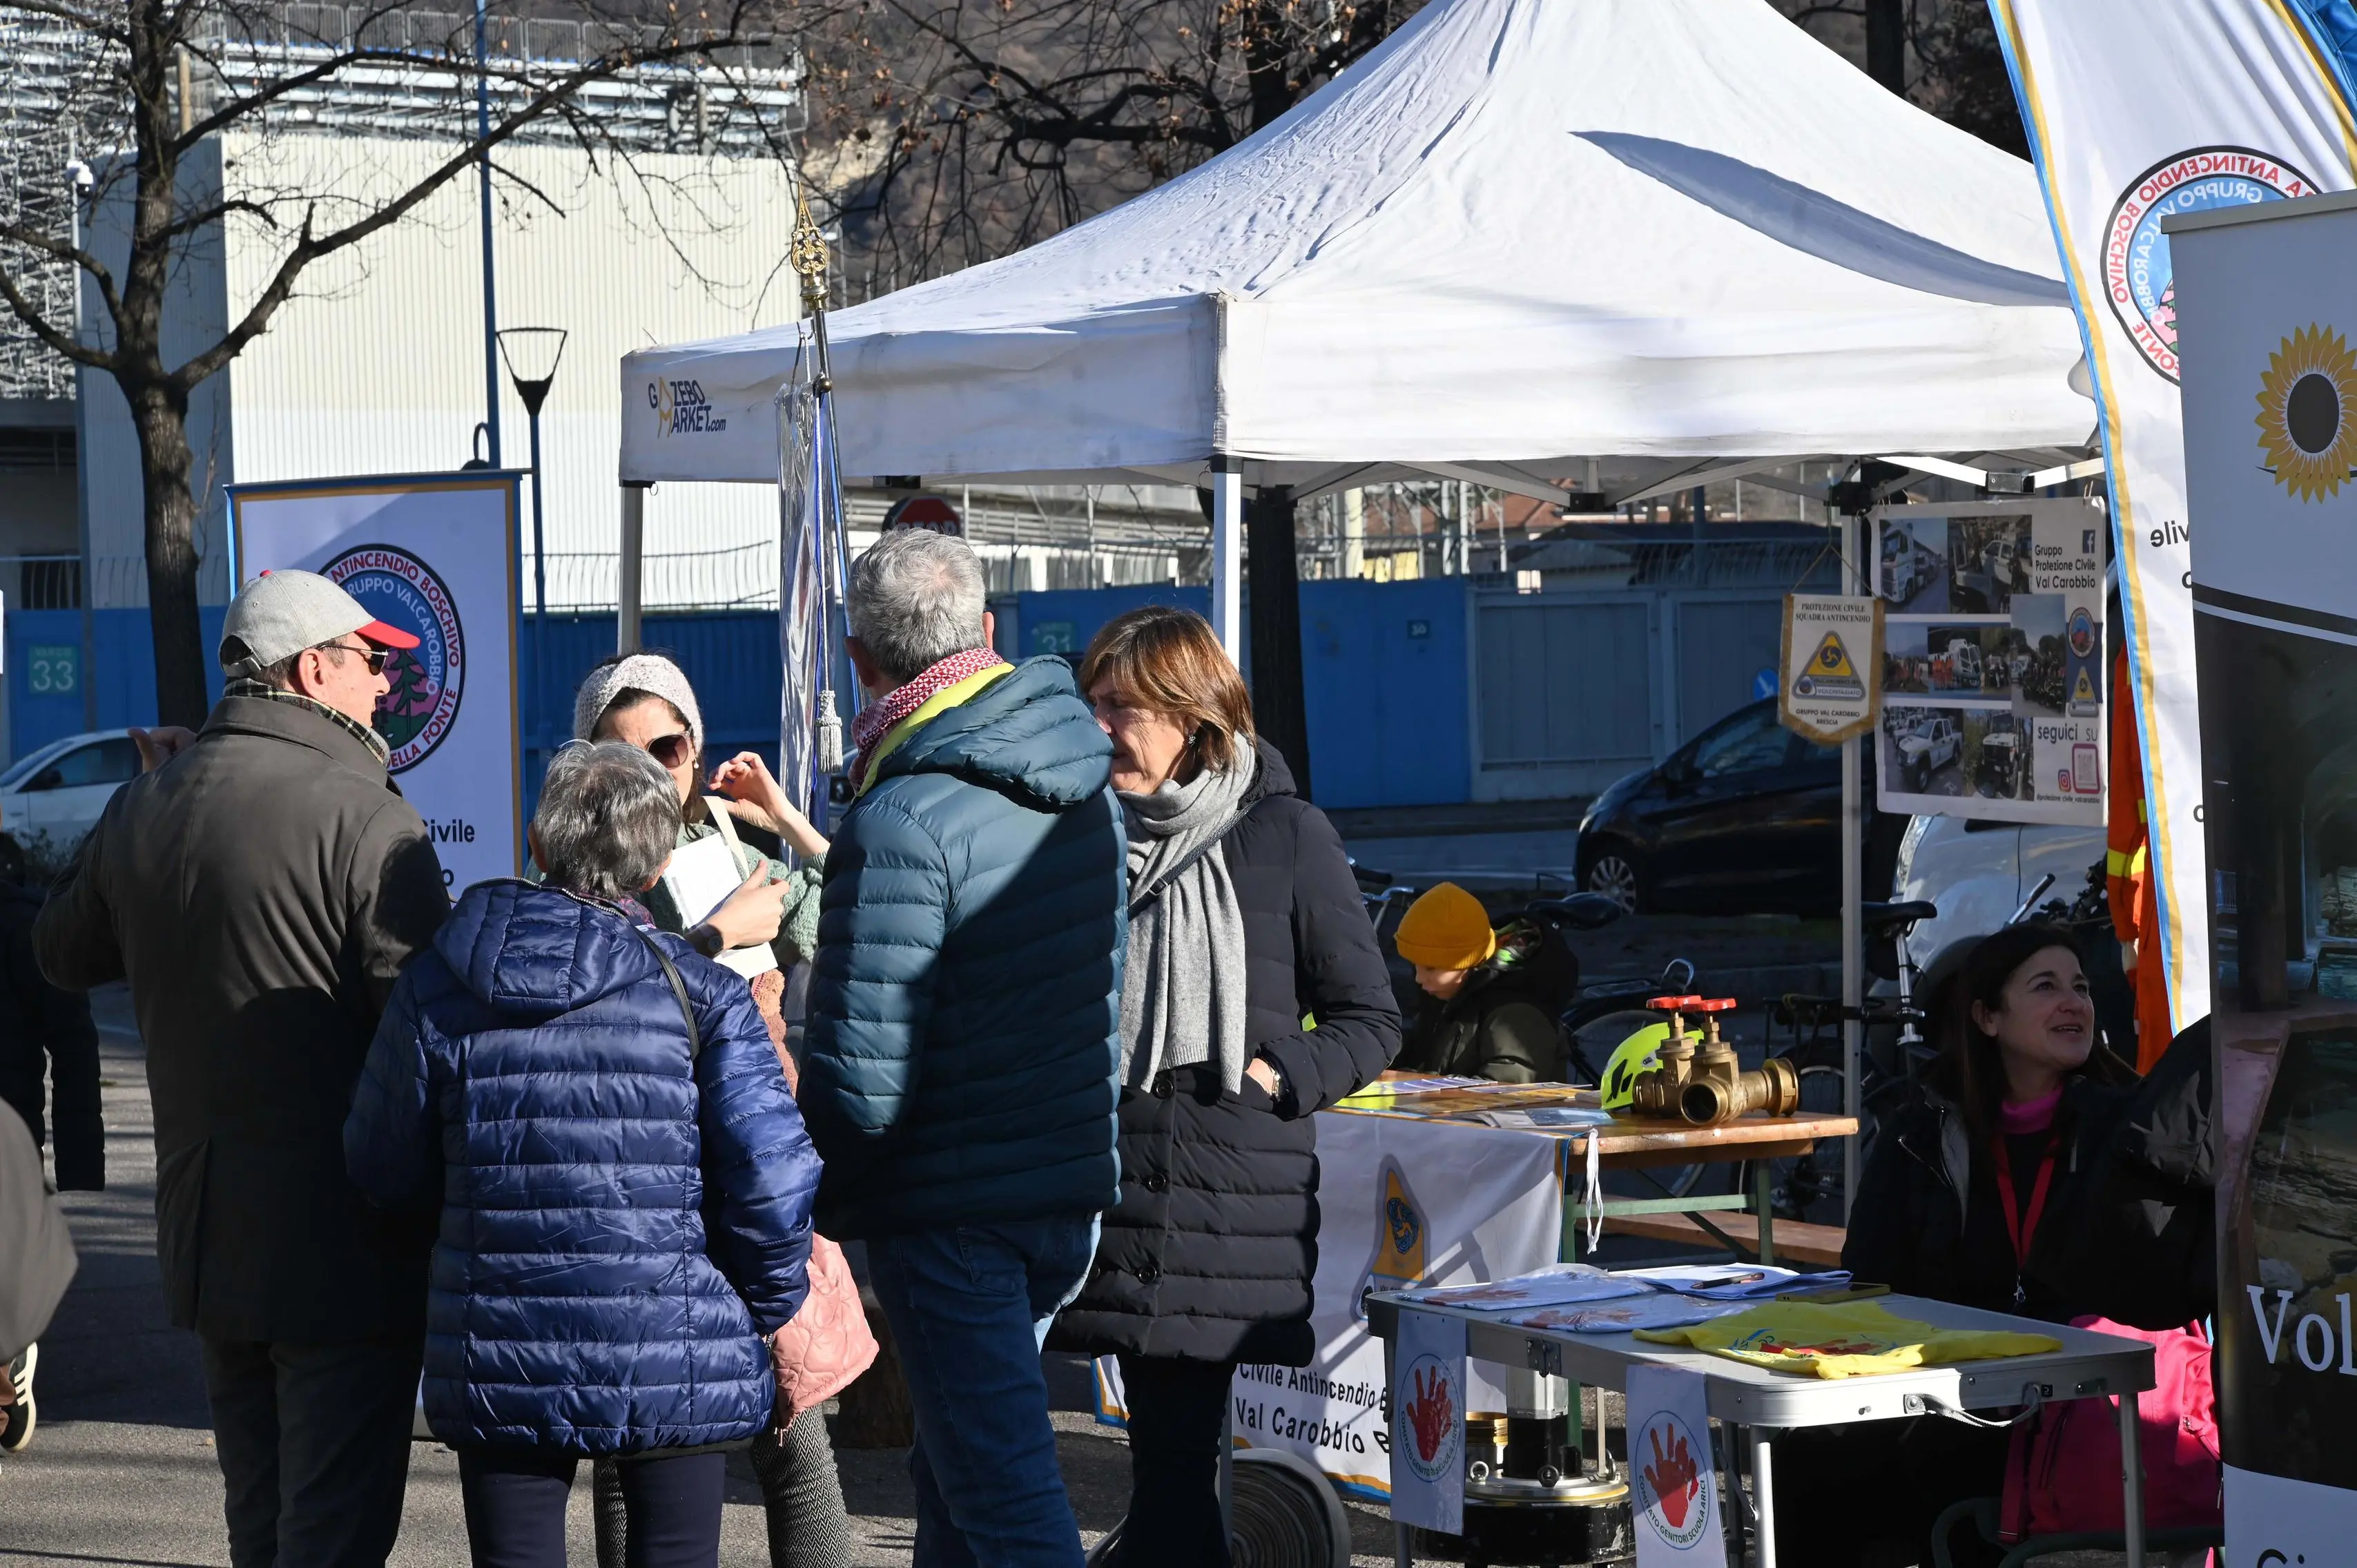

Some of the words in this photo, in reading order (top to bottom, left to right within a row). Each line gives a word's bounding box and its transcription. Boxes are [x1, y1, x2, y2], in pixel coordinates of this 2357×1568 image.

[2035, 544, 2062, 558] Gruppo
[2035, 560, 2073, 571] Protezione
[2075, 559, 2095, 570] Civile
[2035, 575, 2050, 588] Val
[2053, 575, 2095, 588] Carobbio
[331, 552, 419, 583] NTINCENDIO
[420, 576, 460, 668] BOSCHIVO
[1795, 612, 1825, 621] SQUADRA
[1826, 614, 1871, 623] ANTINCENDIO
[1801, 603, 1843, 612] PROTEZIONE
[1843, 604, 1866, 612] CIVILE
[347, 578, 394, 597] RUPPO
[397, 583, 441, 695] VALCAROBBIO
[33, 659, 74, 691] 33
[1817, 688, 1861, 696] VOLONTARIATO
[422, 687, 456, 745] FONTE
[2037, 723, 2078, 744] seguici
[423, 819, 475, 842] ivile
[2246, 1284, 2357, 1376] Vol
[1239, 1363, 1283, 1386] Civile
[1288, 1366, 1375, 1409] Antincendio
[1235, 1396, 1263, 1431] Val
[1272, 1406, 1365, 1454] Carobbio
[1401, 1411, 1413, 1460] COMITATO
[1638, 1475, 1660, 1528] COMITATO
[1660, 1527, 1689, 1544] GENITORI
[1688, 1511, 1705, 1541] SCUOLA
